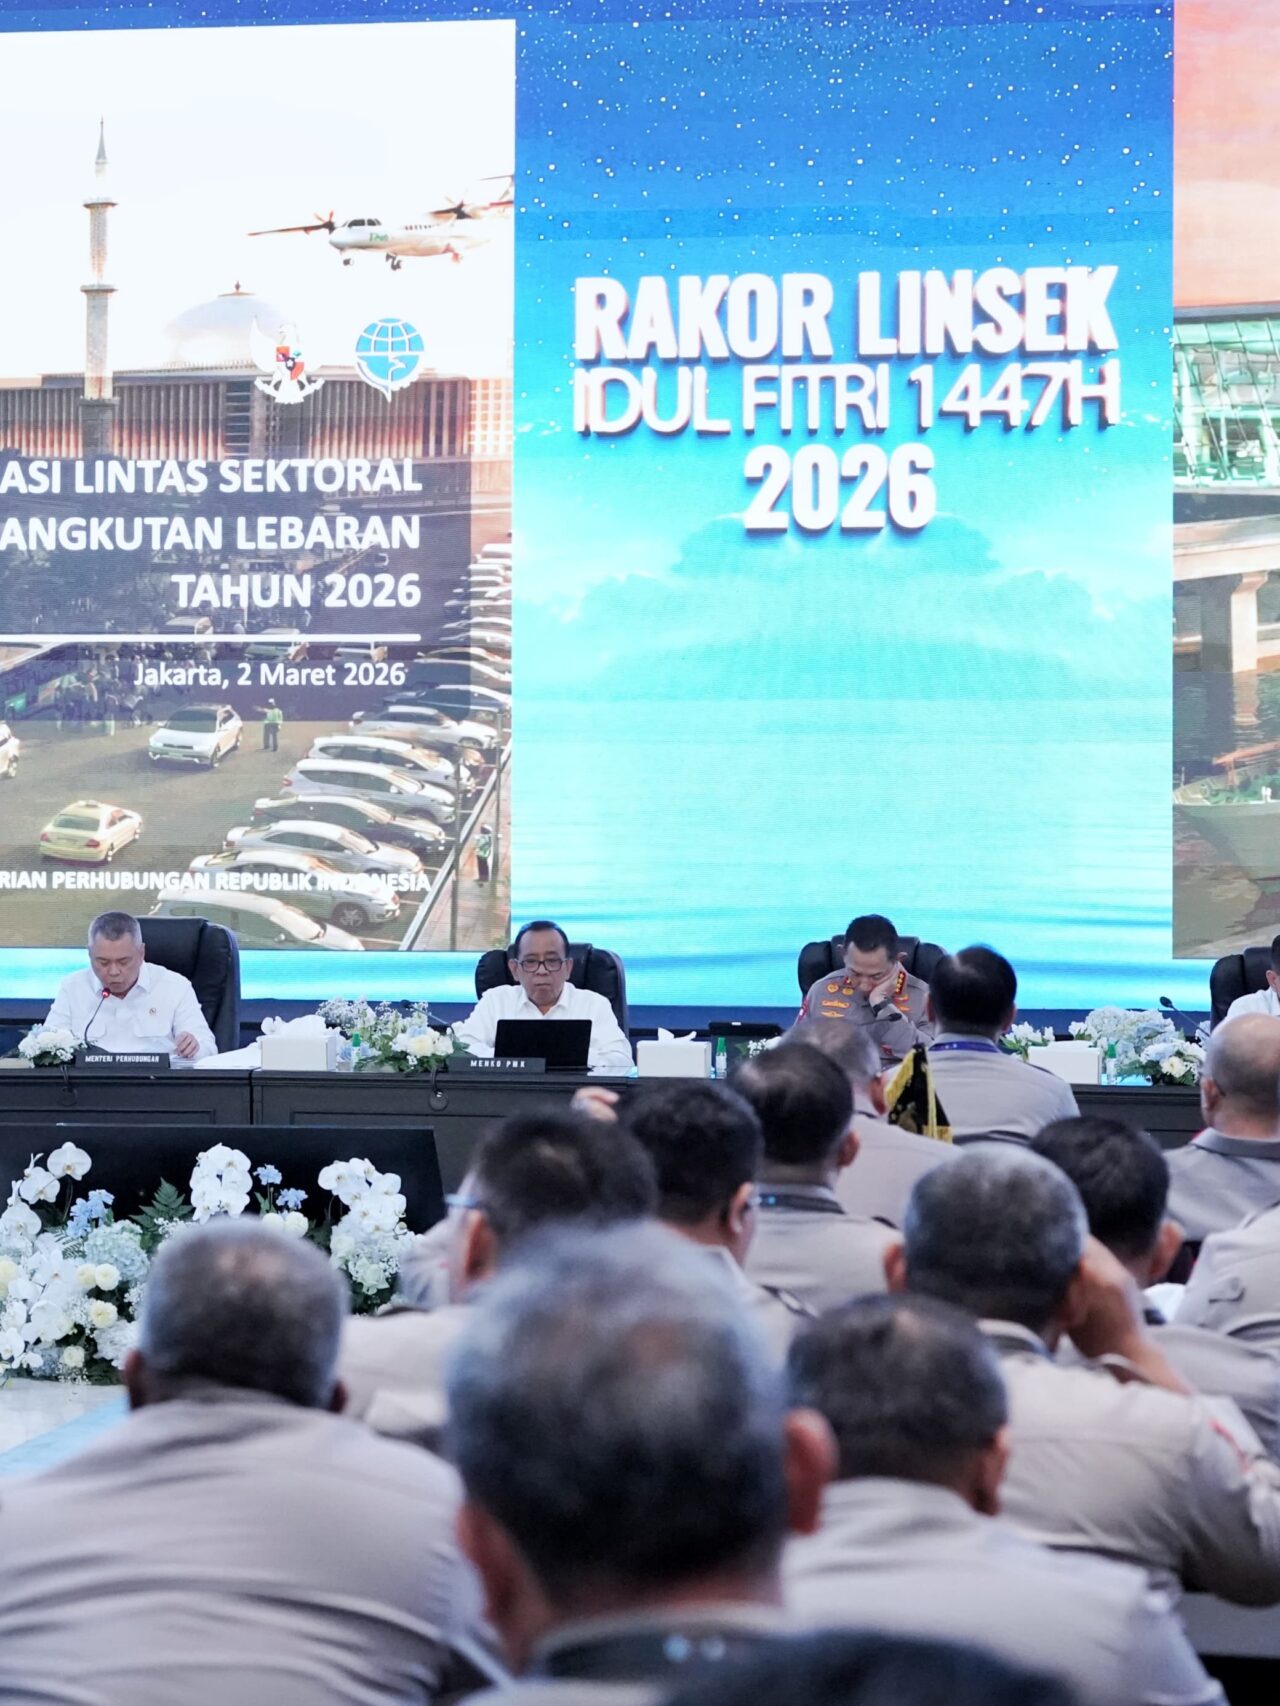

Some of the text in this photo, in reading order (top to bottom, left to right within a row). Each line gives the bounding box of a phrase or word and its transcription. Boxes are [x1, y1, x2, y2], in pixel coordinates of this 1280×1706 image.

[573, 265, 1120, 361] RAKOR LINSEK
[573, 358, 1122, 435] IDUL FITRI 1447H
[74, 459, 209, 494] LINTAS
[219, 457, 422, 494] SEKTORAL
[742, 443, 938, 531] 2026
[236, 515, 421, 550] LEBARAN
[171, 573, 421, 608] TAHUN 2026
[134, 662, 406, 690] Jakarta, 2 Maret 2026
[52, 871, 210, 890] PERHUBUNGAN
[215, 871, 313, 891] REPUBLIK
[85, 1055, 113, 1063] MENTERI
